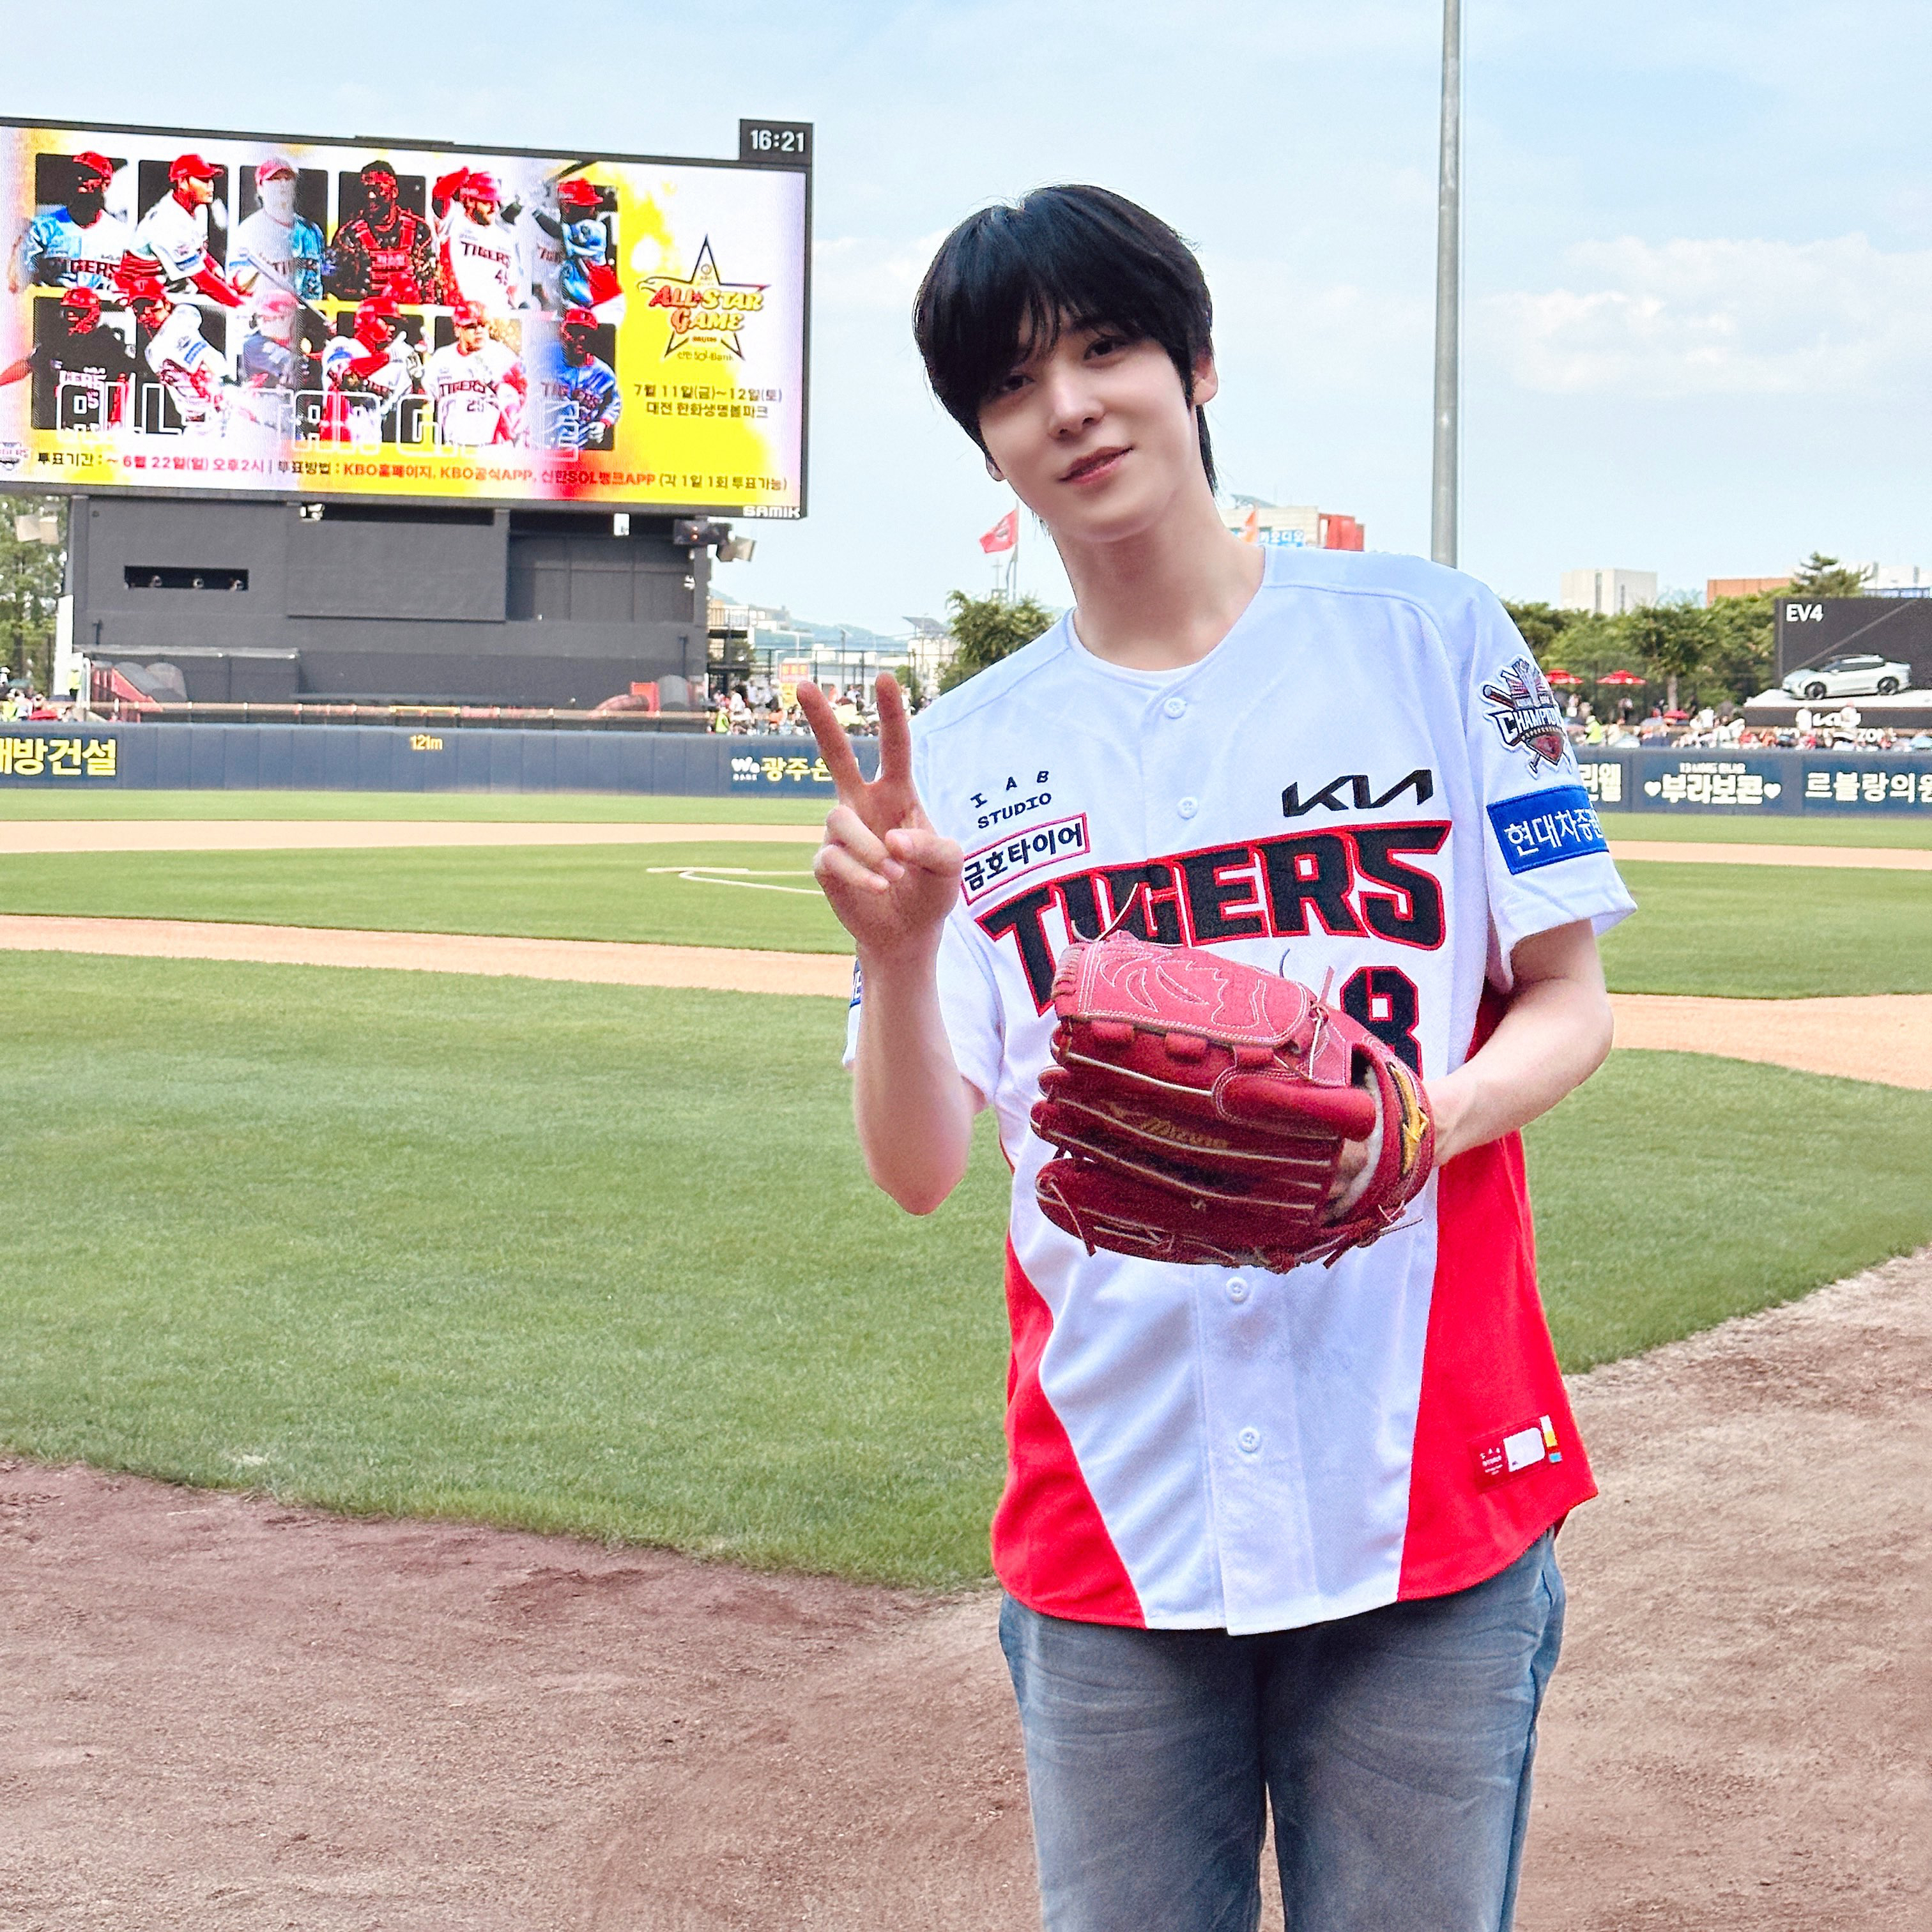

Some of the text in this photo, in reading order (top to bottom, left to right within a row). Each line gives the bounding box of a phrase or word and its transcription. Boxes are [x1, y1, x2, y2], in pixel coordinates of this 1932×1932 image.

[750, 130, 804, 152] 16:21
[670, 308, 745, 334] GAME
[645, 401, 673, 415] 대전
[1786, 603, 1824, 622] EV4
[410, 734, 443, 750] 121m
[760, 756, 837, 782] 광주은
[1281, 769, 1434, 818] KIA
[1662, 774, 1763, 804] 부라보콘
[977, 792, 1052, 829] STUDIO
[964, 822, 1083, 891] 금호타이어
[976, 820, 1453, 1017] TIGERS
[1340, 965, 1421, 1080] 8
